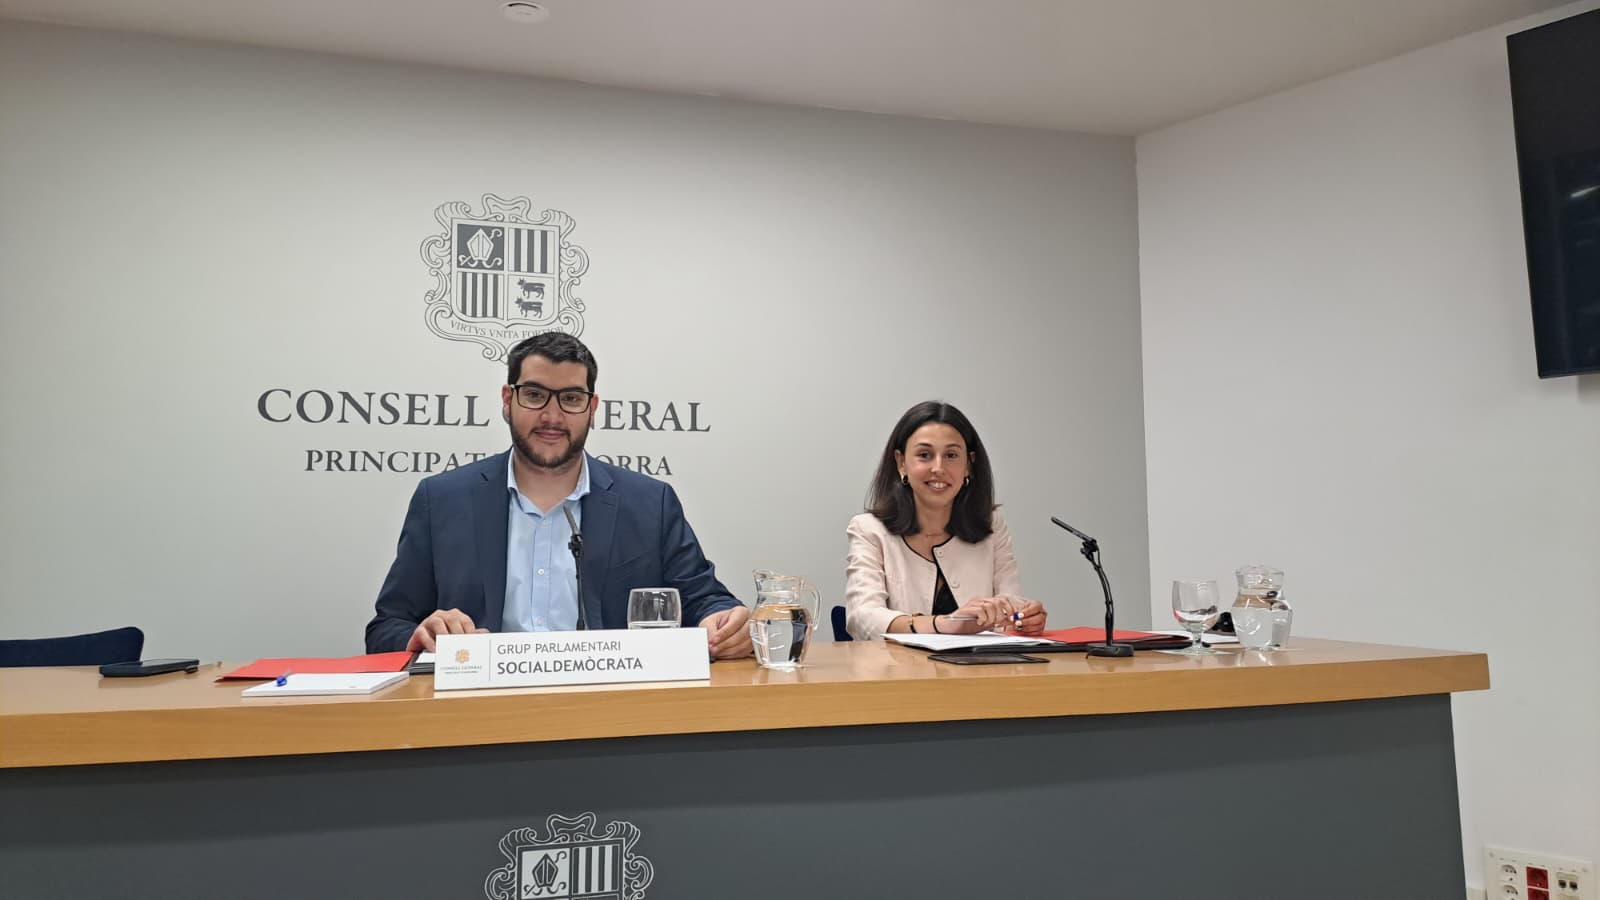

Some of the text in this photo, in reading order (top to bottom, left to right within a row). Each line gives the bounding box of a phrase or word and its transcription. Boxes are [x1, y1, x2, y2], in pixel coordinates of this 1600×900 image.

[257, 388, 490, 428] CONSELL
[497, 640, 621, 655] GRUP PARLAMENTARI
[497, 656, 643, 675] SOCIALDEMÒCRATA
